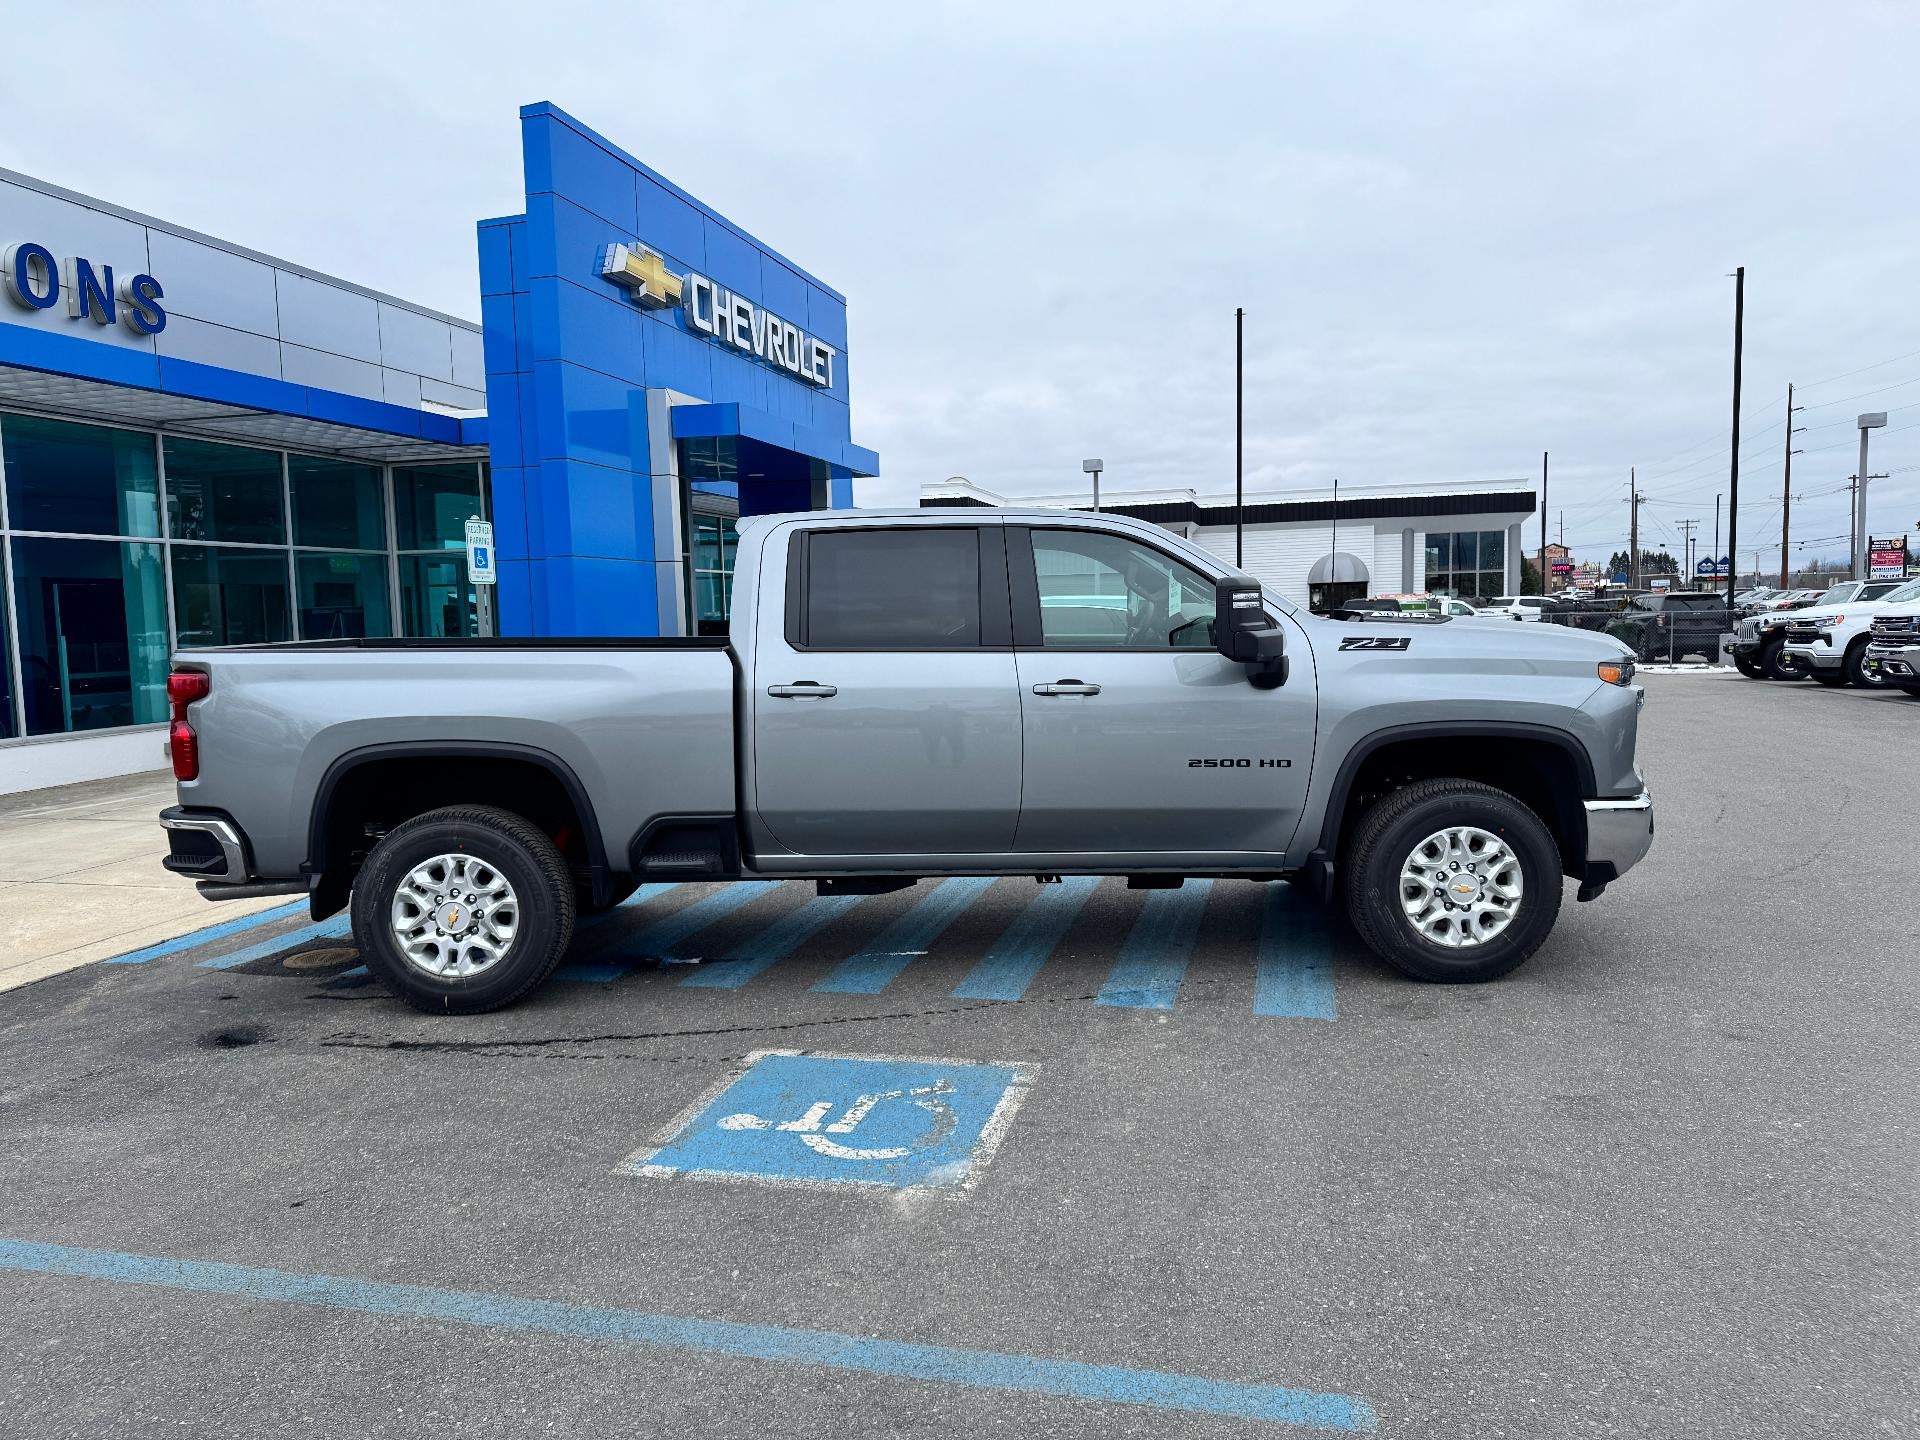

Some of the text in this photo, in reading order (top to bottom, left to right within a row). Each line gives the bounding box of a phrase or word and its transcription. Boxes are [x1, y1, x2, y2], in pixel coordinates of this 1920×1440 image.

[5, 243, 166, 334] ONS
[682, 273, 836, 388] CHEVROLET
[469, 536, 490, 545] PARKING
[1338, 637, 1411, 651] Z71
[1188, 759, 1292, 768] 2500 HD
